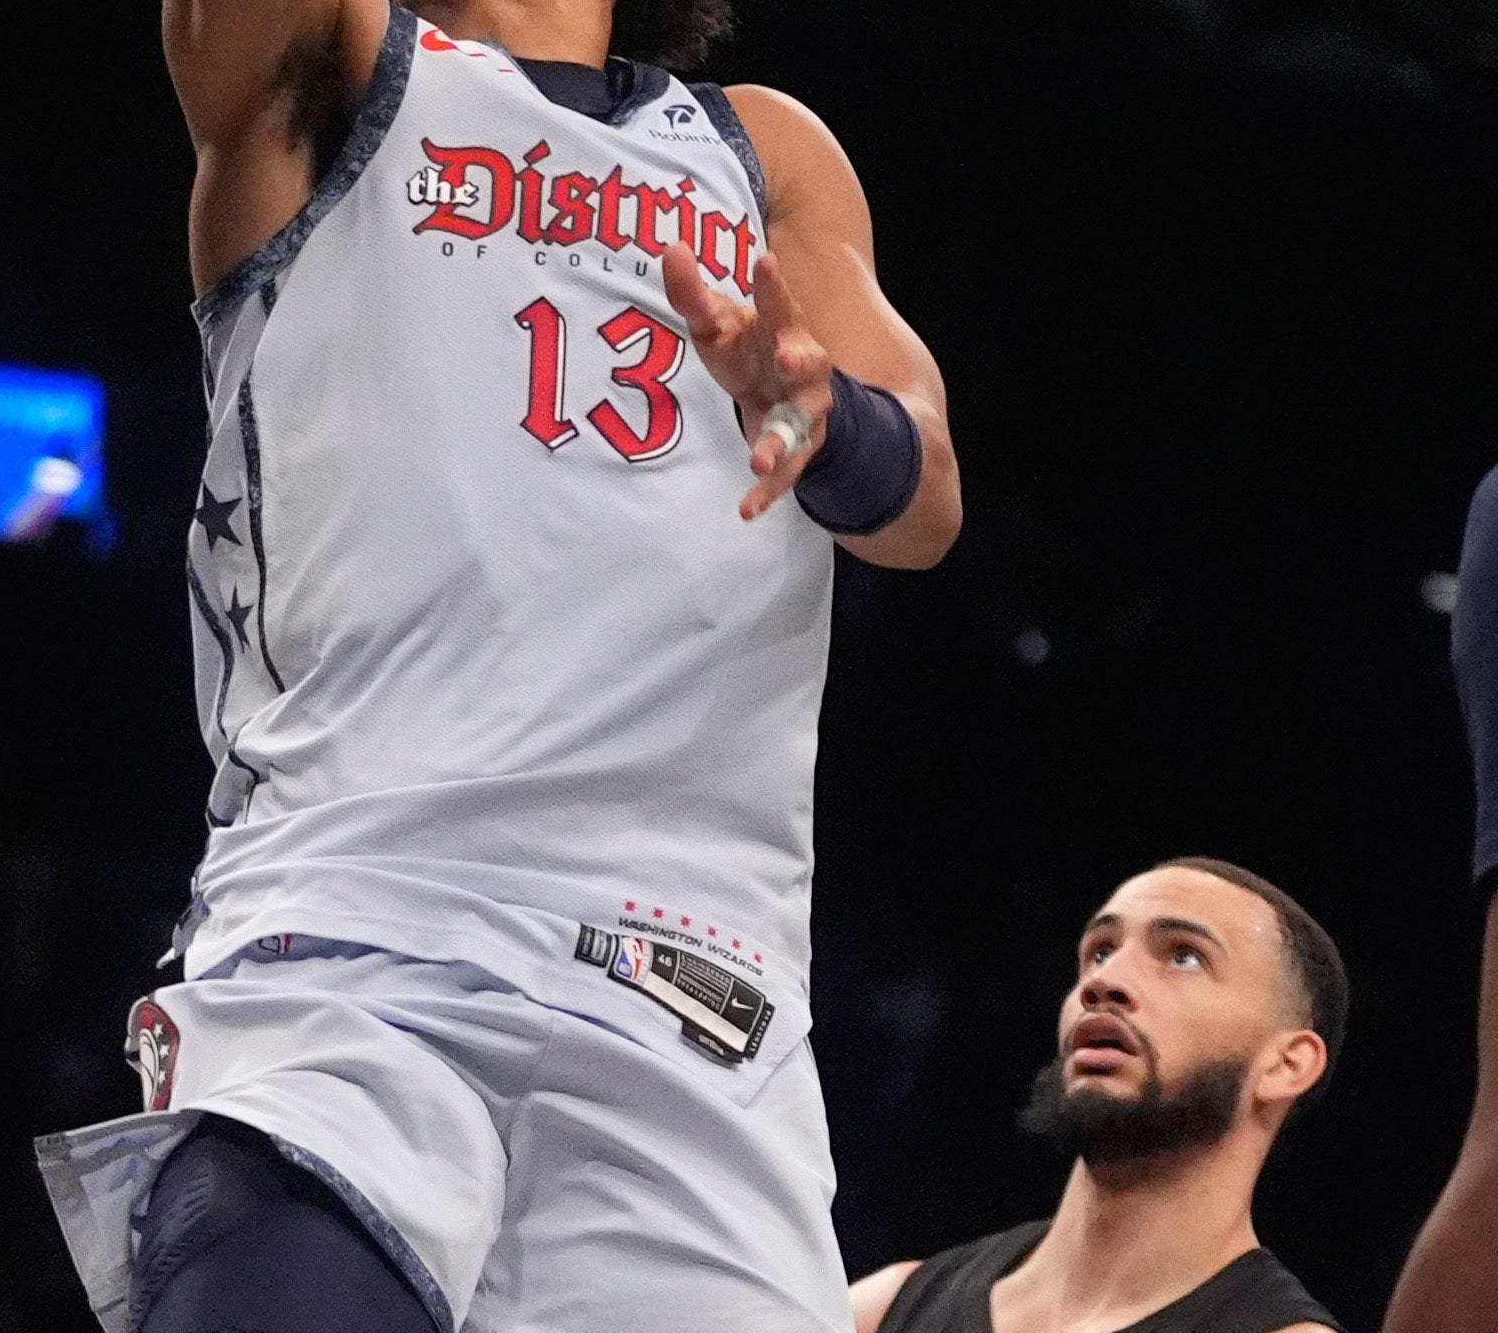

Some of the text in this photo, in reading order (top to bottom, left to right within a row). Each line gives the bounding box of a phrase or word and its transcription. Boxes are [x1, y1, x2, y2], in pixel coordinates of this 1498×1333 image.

[406, 136, 757, 298] the District
[442, 242, 648, 277] OF COLU
[514, 296, 686, 464] 13
[618, 916, 704, 948] WASHINGTON
[707, 942, 764, 978] WIZARDS
